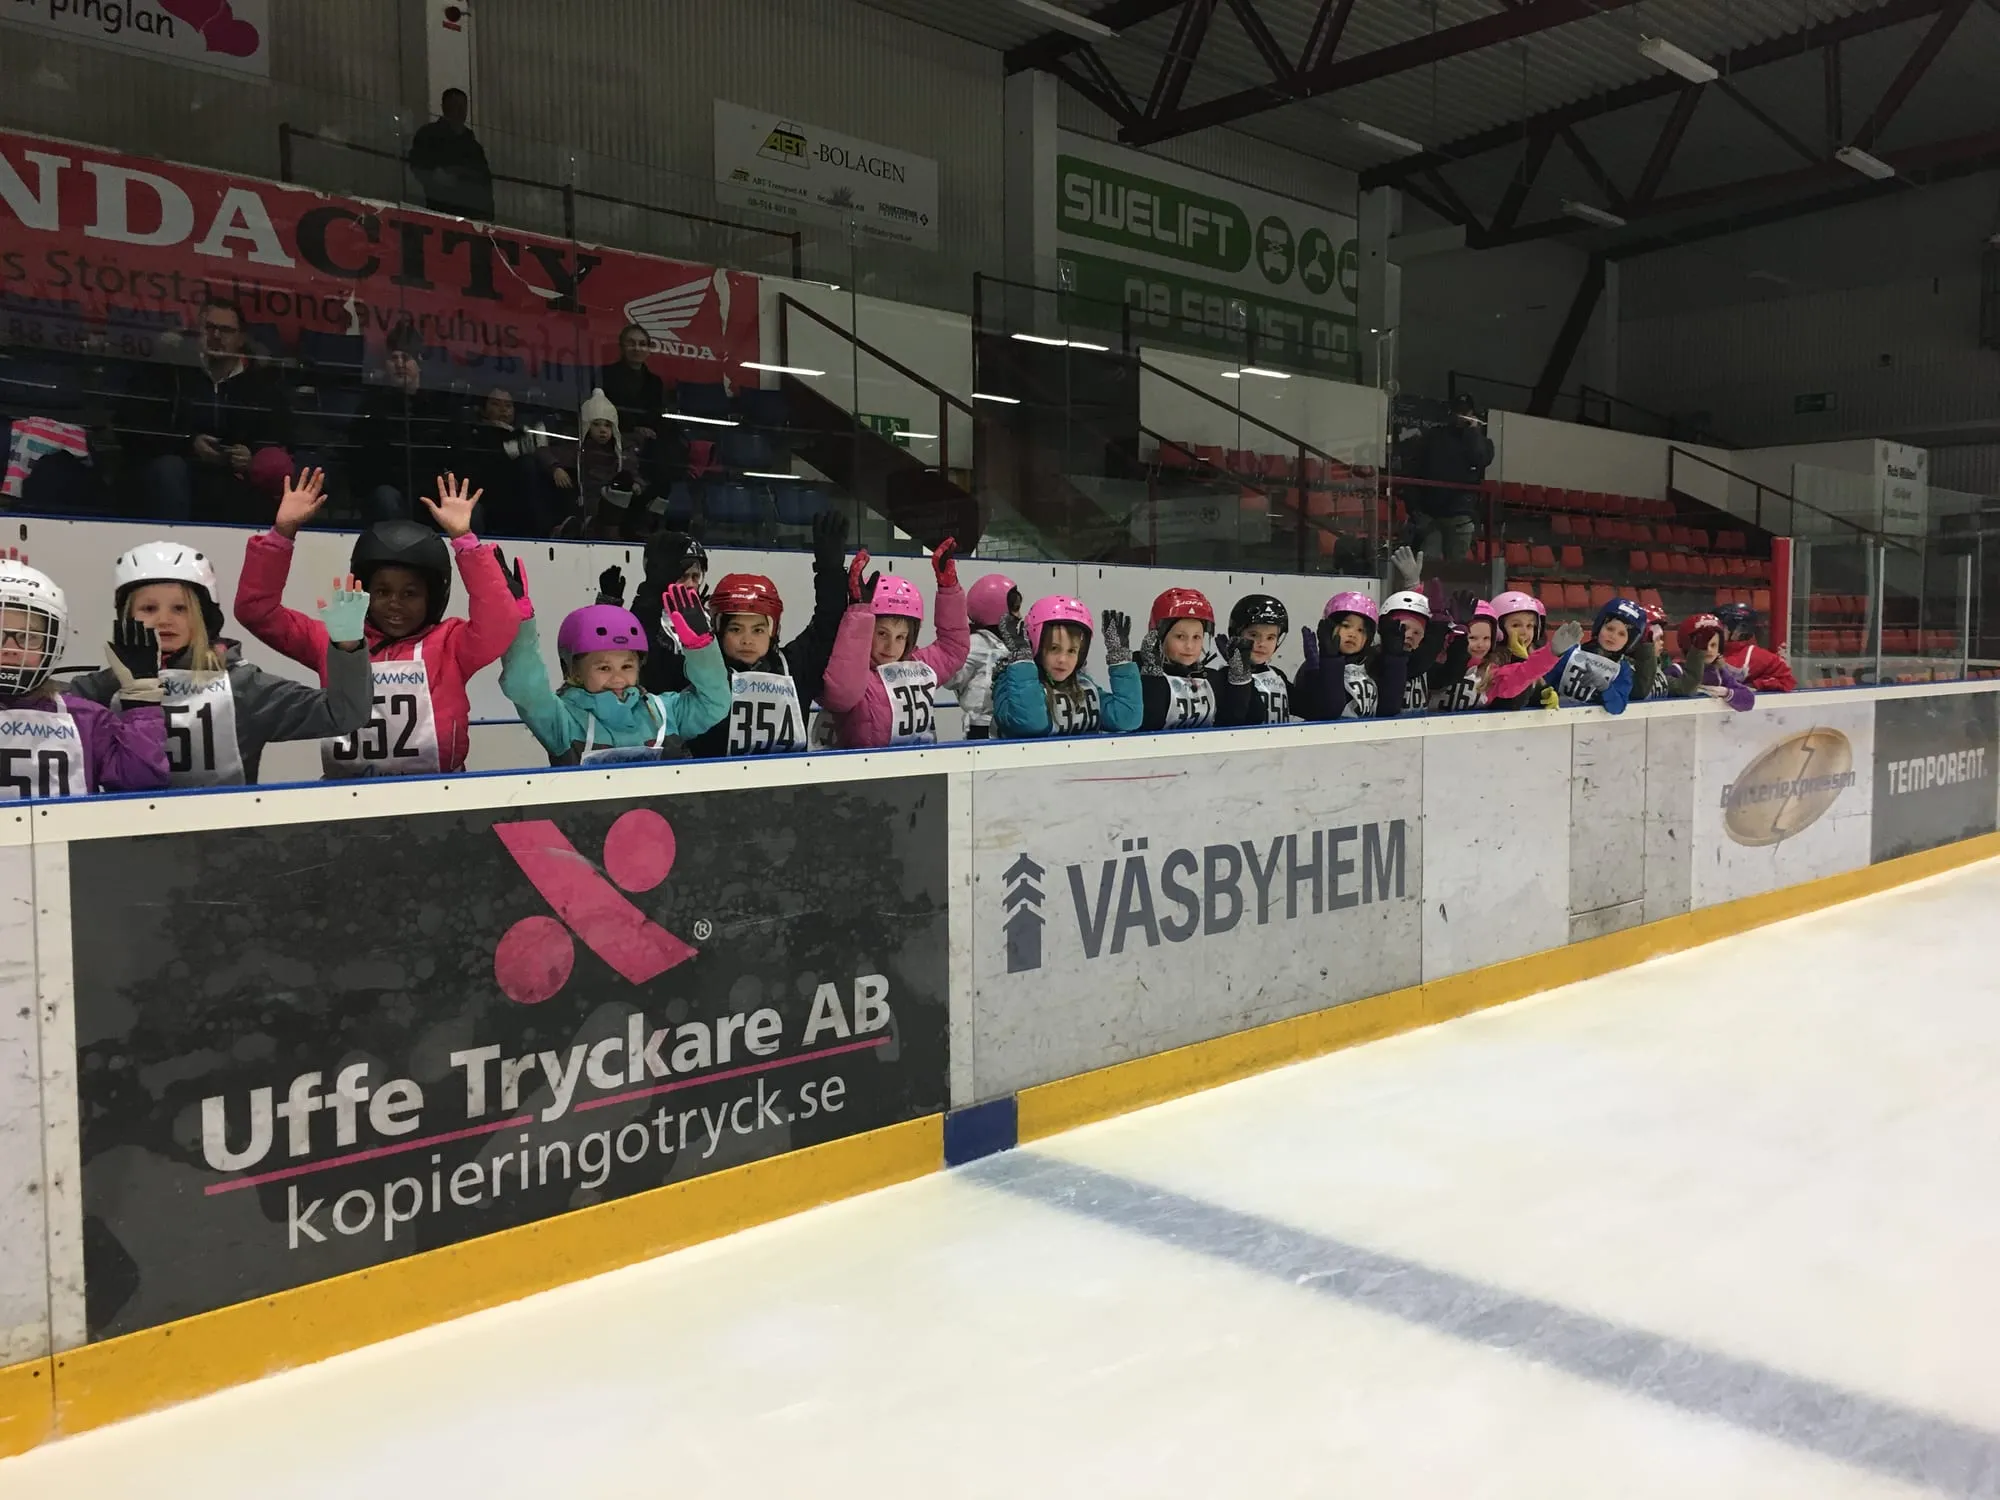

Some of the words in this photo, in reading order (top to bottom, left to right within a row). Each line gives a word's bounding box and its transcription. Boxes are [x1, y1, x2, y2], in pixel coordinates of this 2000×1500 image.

[1064, 172, 1234, 257] SWELIFT
[46, 250, 212, 304] Största
[646, 337, 717, 361] ONDA
[0, 577, 40, 588] OFA
[730, 701, 795, 753] 354
[1888, 748, 1985, 797] TEMPORENT
[1065, 818, 1406, 960] VÄSBYHEM
[200, 1062, 424, 1173] Uffe
[448, 1006, 784, 1122] Tryckare
[800, 973, 891, 1046] AB
[287, 1071, 846, 1249] kopieringotryck.se
